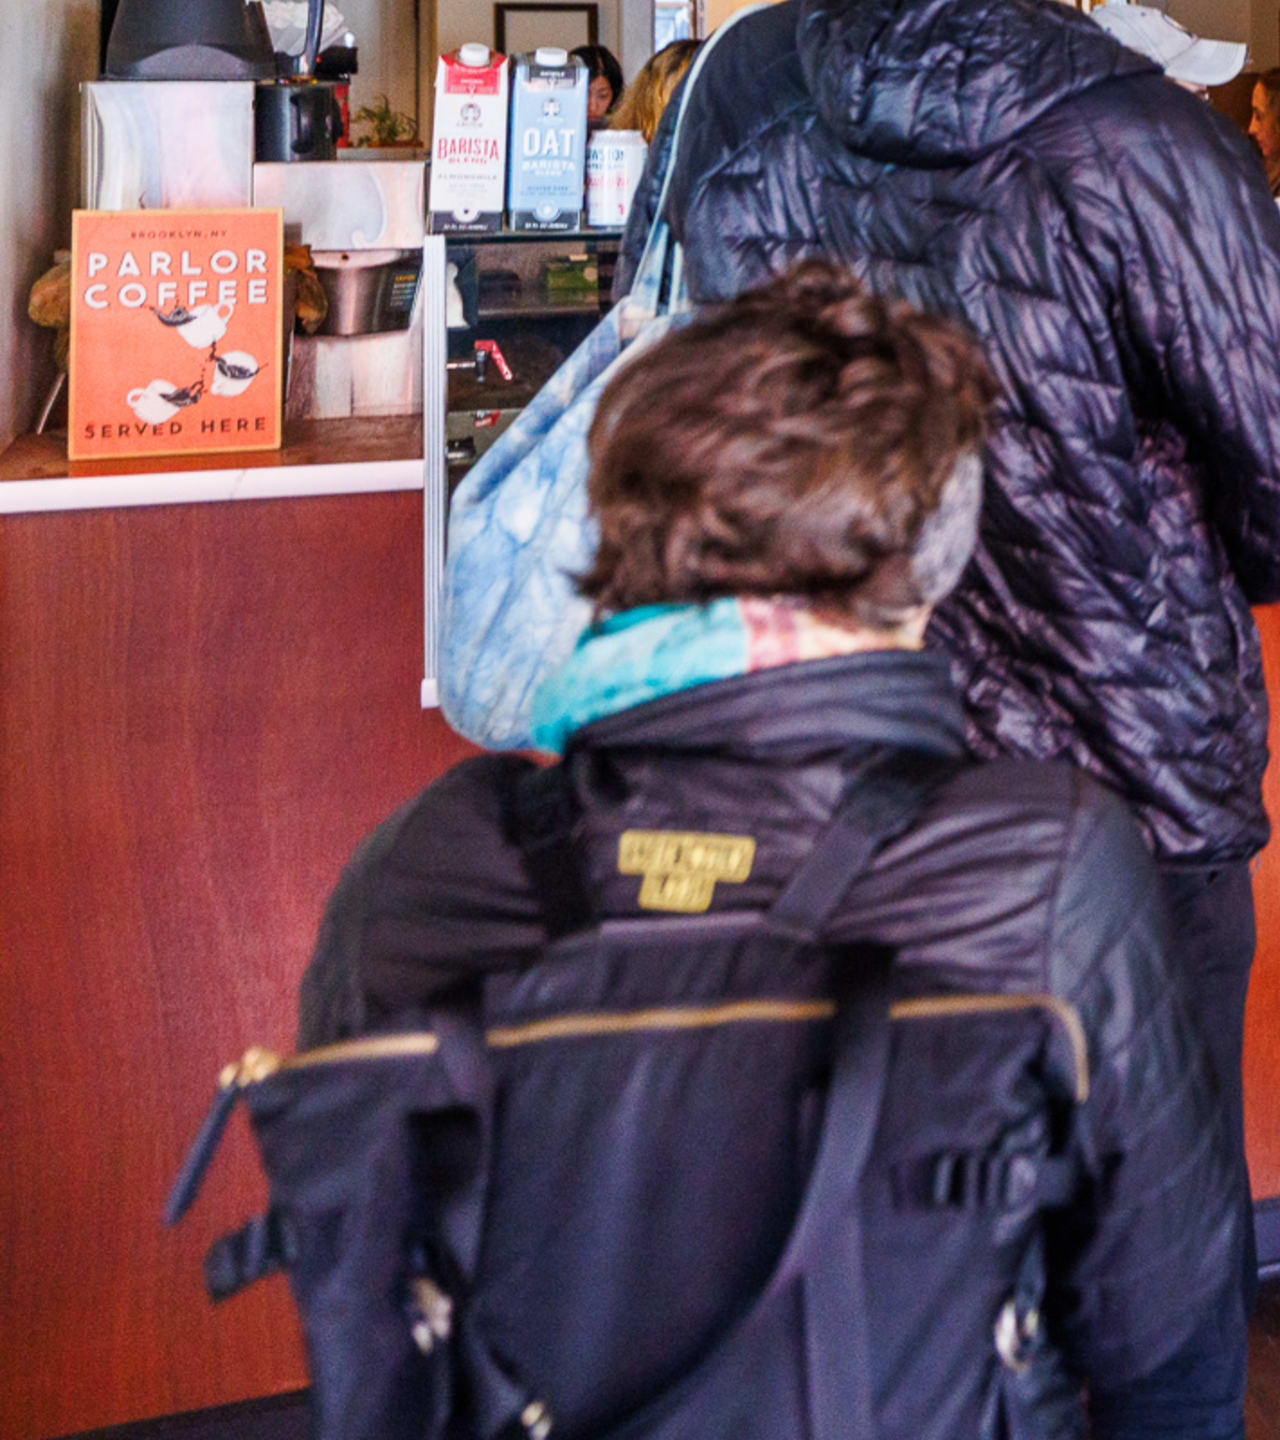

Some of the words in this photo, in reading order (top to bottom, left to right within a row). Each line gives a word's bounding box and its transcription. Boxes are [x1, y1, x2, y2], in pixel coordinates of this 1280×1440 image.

[436, 137, 499, 160] BARISTA
[523, 127, 576, 158] OAT
[521, 160, 576, 172] BARISTA
[87, 249, 268, 279] PARLOR
[84, 278, 268, 309] COFFEE
[84, 421, 183, 440] SERVED
[200, 416, 267, 434] HERE
